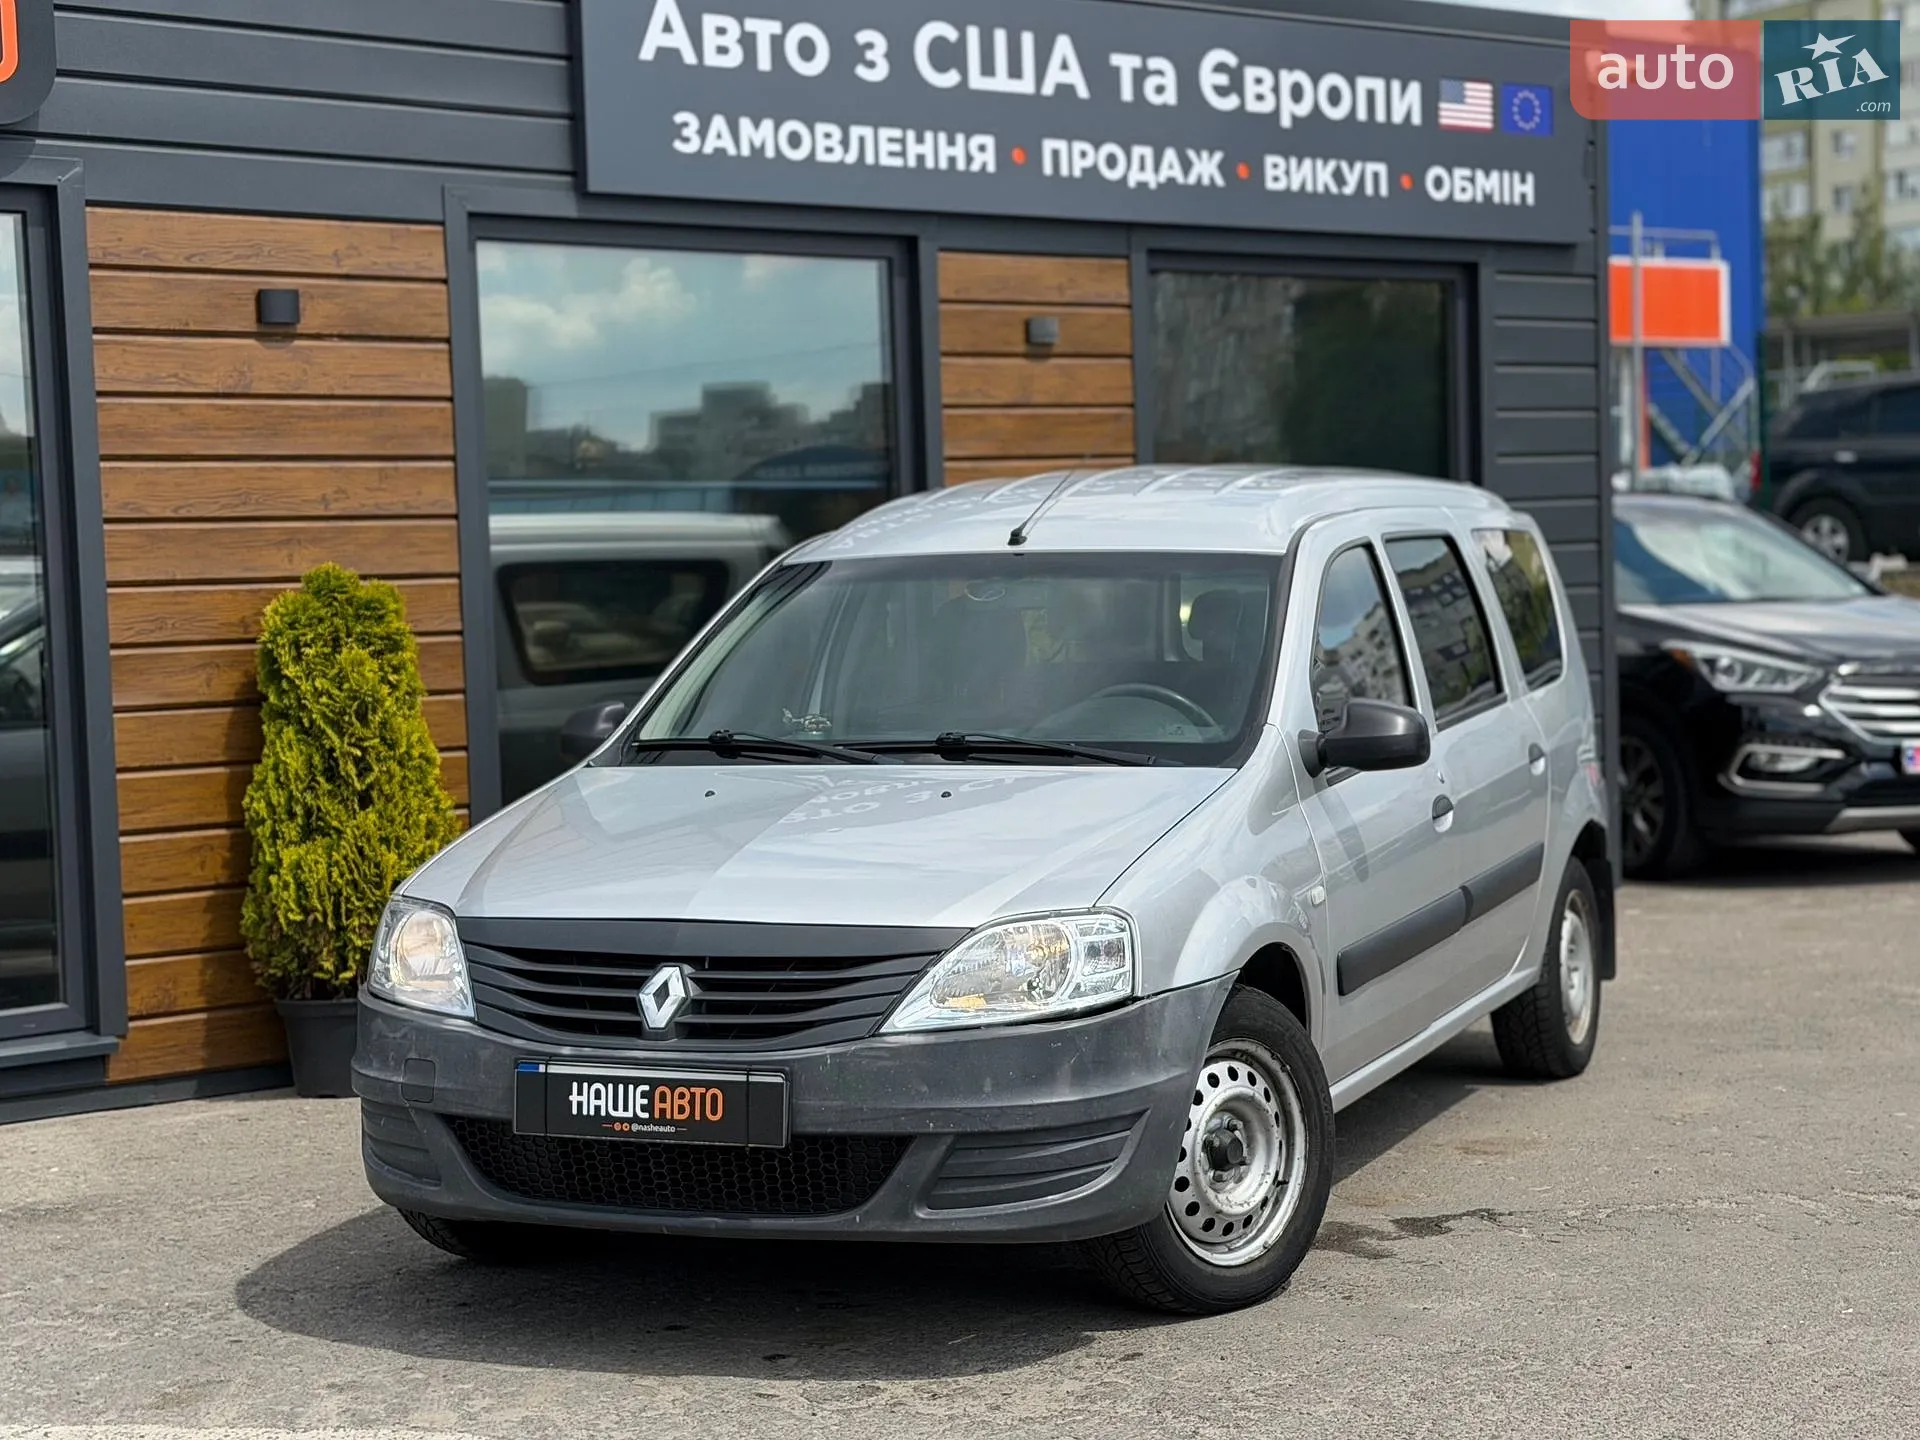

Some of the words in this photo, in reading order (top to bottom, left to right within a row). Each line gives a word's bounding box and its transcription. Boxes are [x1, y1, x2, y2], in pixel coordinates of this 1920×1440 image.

[638, 0, 831, 77] Авто
[854, 28, 890, 83] з
[913, 20, 1090, 100] США
[1109, 52, 1178, 106] та
[1198, 48, 1422, 129] Європи
[672, 111, 997, 174] ЗАМОВЛЕННЯ
[1041, 138, 1225, 190] ПРОДАЖ
[1264, 154, 1389, 197] ВИКУП
[1425, 165, 1535, 206] ОБМІН
[631, 1122, 676, 1133] @nasheauto
